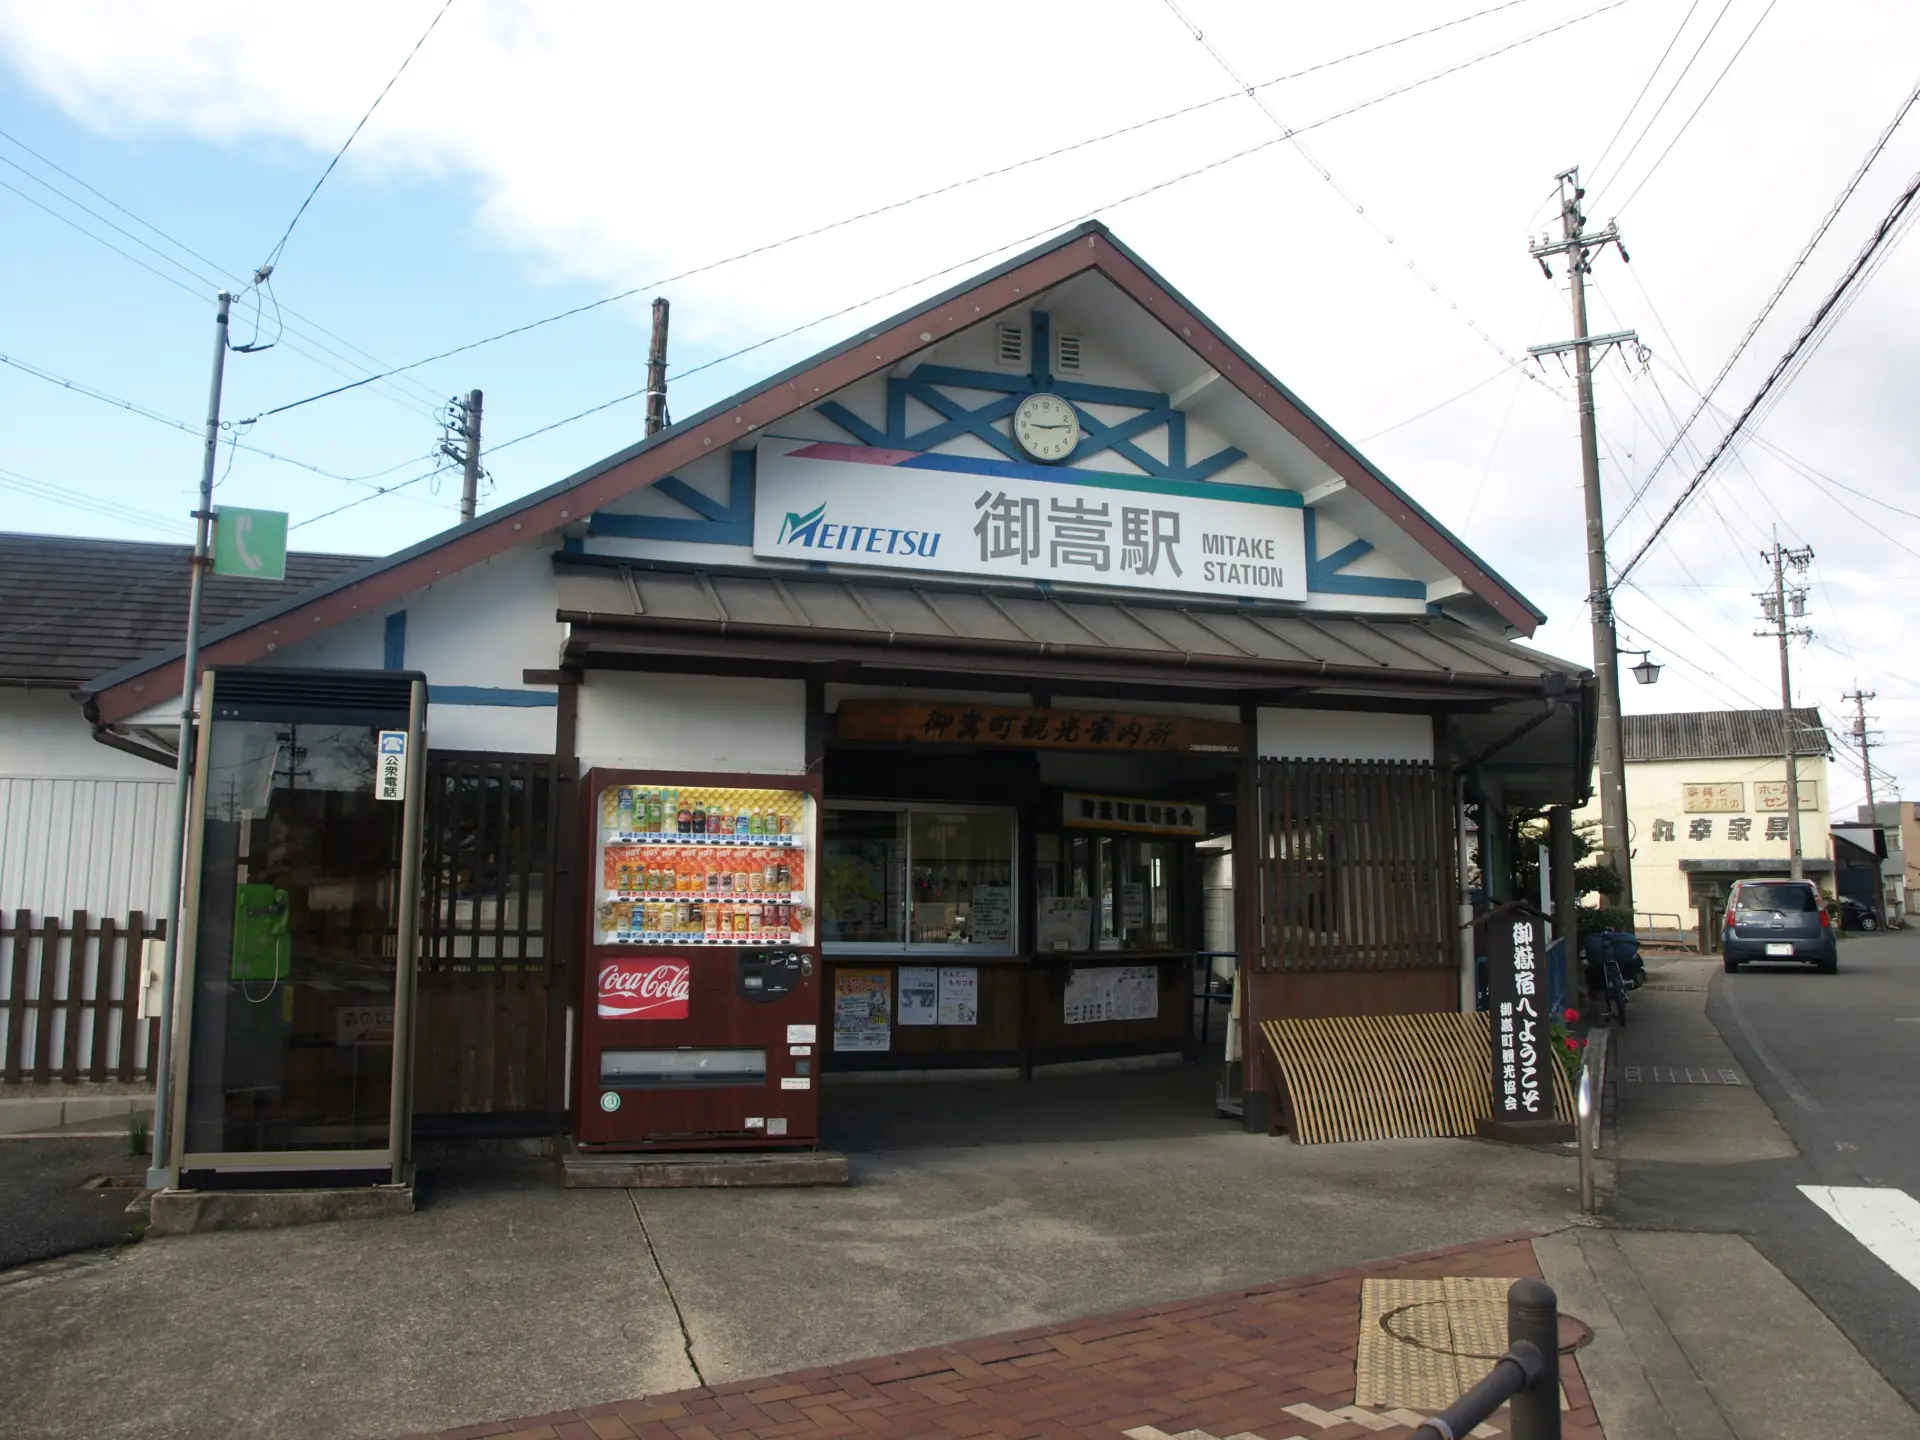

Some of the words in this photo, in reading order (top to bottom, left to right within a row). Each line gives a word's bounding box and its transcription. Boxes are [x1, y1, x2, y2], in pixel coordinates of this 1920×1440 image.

[1032, 403, 1039, 411] 11
[1042, 401, 1050, 410] 12
[1055, 405, 1060, 413] 1
[1023, 410, 1032, 418] 10
[1062, 414, 1068, 423] 2
[1020, 420, 1027, 429] 9
[1066, 426, 1072, 434] 3
[1023, 432, 1030, 440] 8
[1062, 437, 1068, 445] 4
[1032, 442, 1039, 450] 7
[1043, 446, 1049, 454] 6
[1054, 444, 1060, 452] 5
[777, 501, 941, 557] MEITETSU
[973, 490, 1183, 578] 御嵩駅
[1202, 533, 1275, 560] MITAKE
[1203, 561, 1284, 588] STATION
[921, 708, 1175, 747] 御嵩町観光案内所
[383, 755, 399, 798] 公衆電話
[1762, 796, 1812, 808] センー
[598, 965, 689, 999] Coca-Cola
[1512, 922, 1540, 1113] 御嶽宿へようこそ
[1500, 1002, 1517, 1111] 御嵩町観光協会
